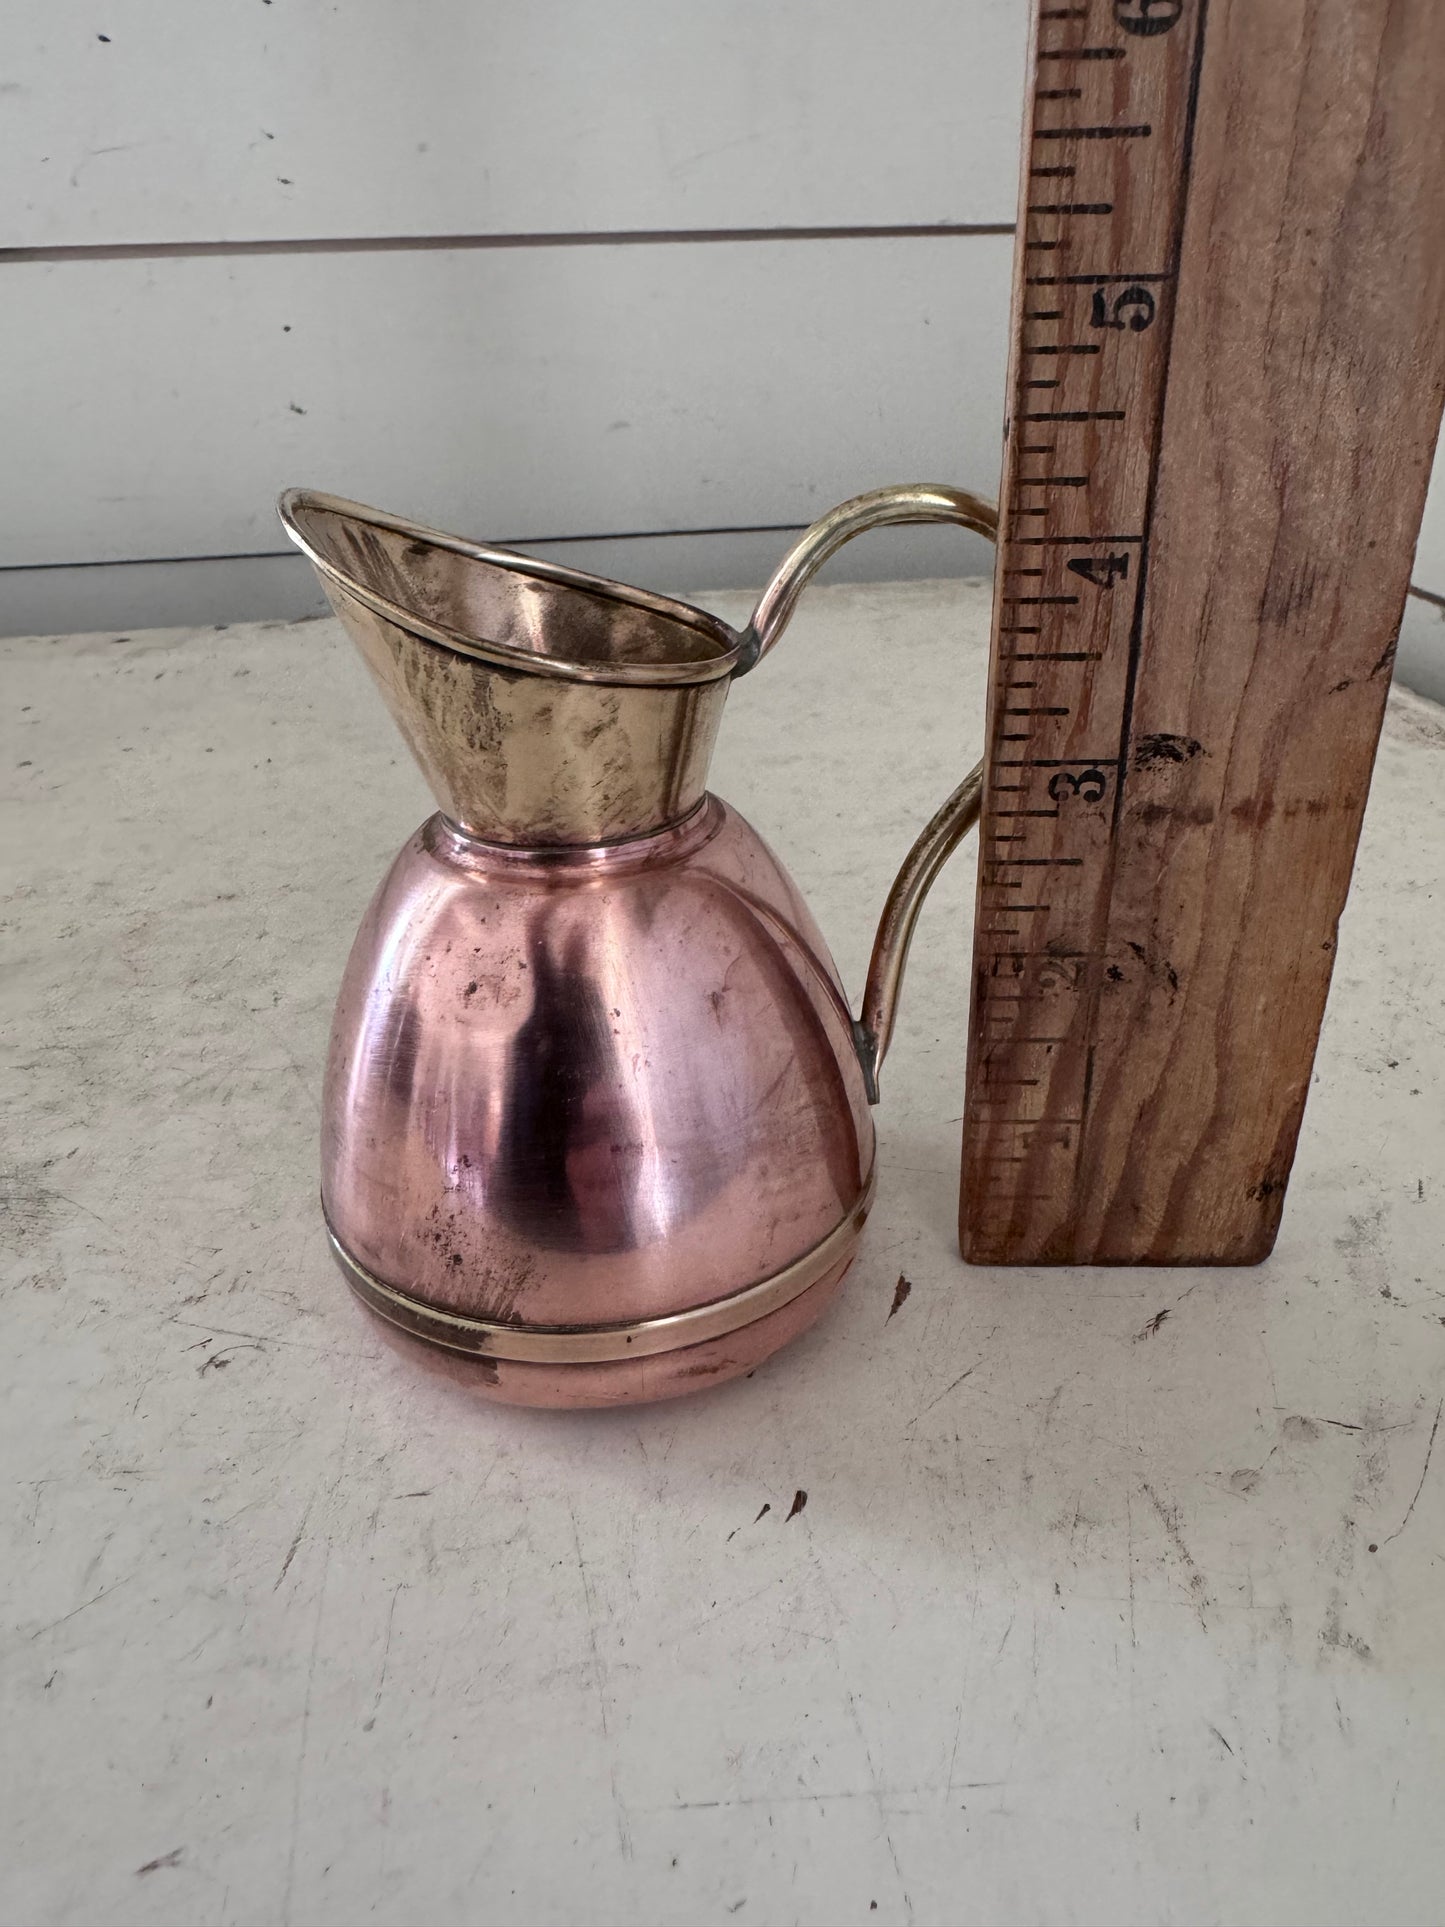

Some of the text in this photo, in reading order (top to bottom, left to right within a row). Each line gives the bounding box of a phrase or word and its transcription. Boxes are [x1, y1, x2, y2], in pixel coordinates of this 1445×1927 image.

[1089, 286, 1155, 332] 5
[1066, 552, 1129, 589] 4
[1048, 769, 1106, 802] 3
[1038, 959, 1087, 990] 2
